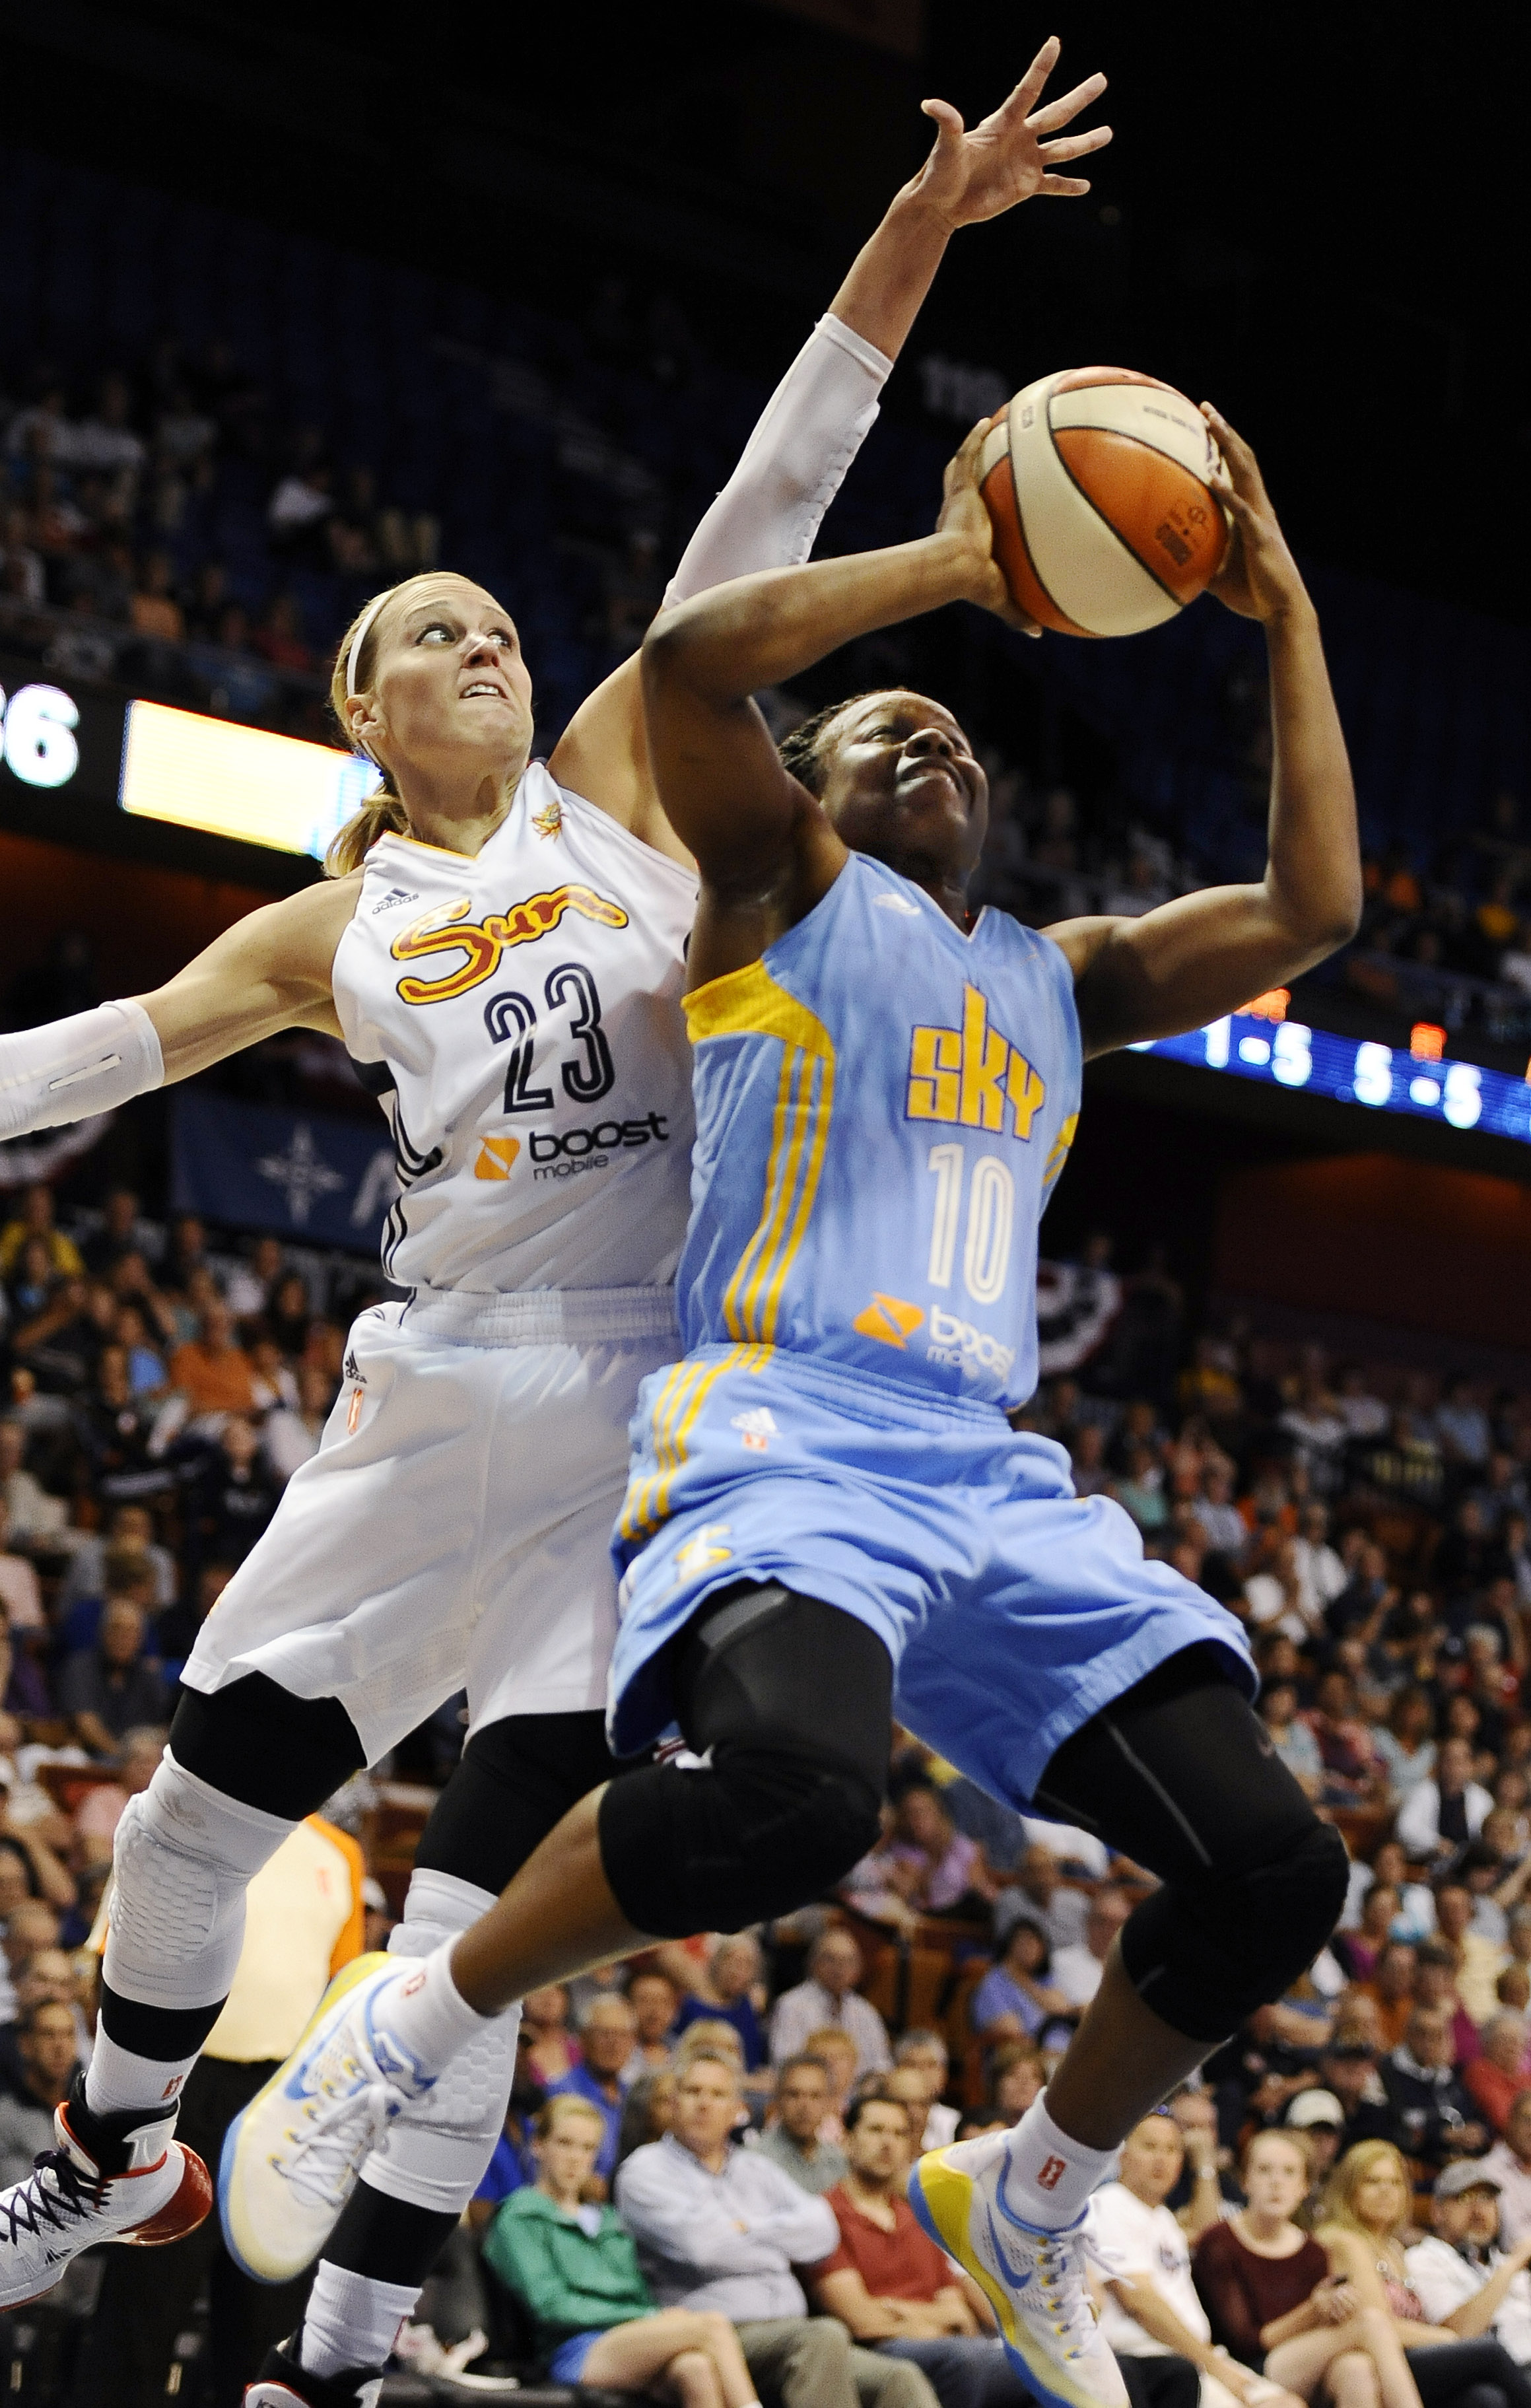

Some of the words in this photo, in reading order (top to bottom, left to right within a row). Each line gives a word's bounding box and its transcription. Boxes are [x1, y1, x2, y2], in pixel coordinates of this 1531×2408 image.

[0, 683, 79, 788] 6
[372, 891, 419, 915] adidas
[390, 883, 629, 1006] Sun
[483, 962, 615, 1115] 23
[529, 1111, 669, 1163] boost
[533, 1151, 610, 1181] mobile
[927, 1142, 1014, 1305] 10
